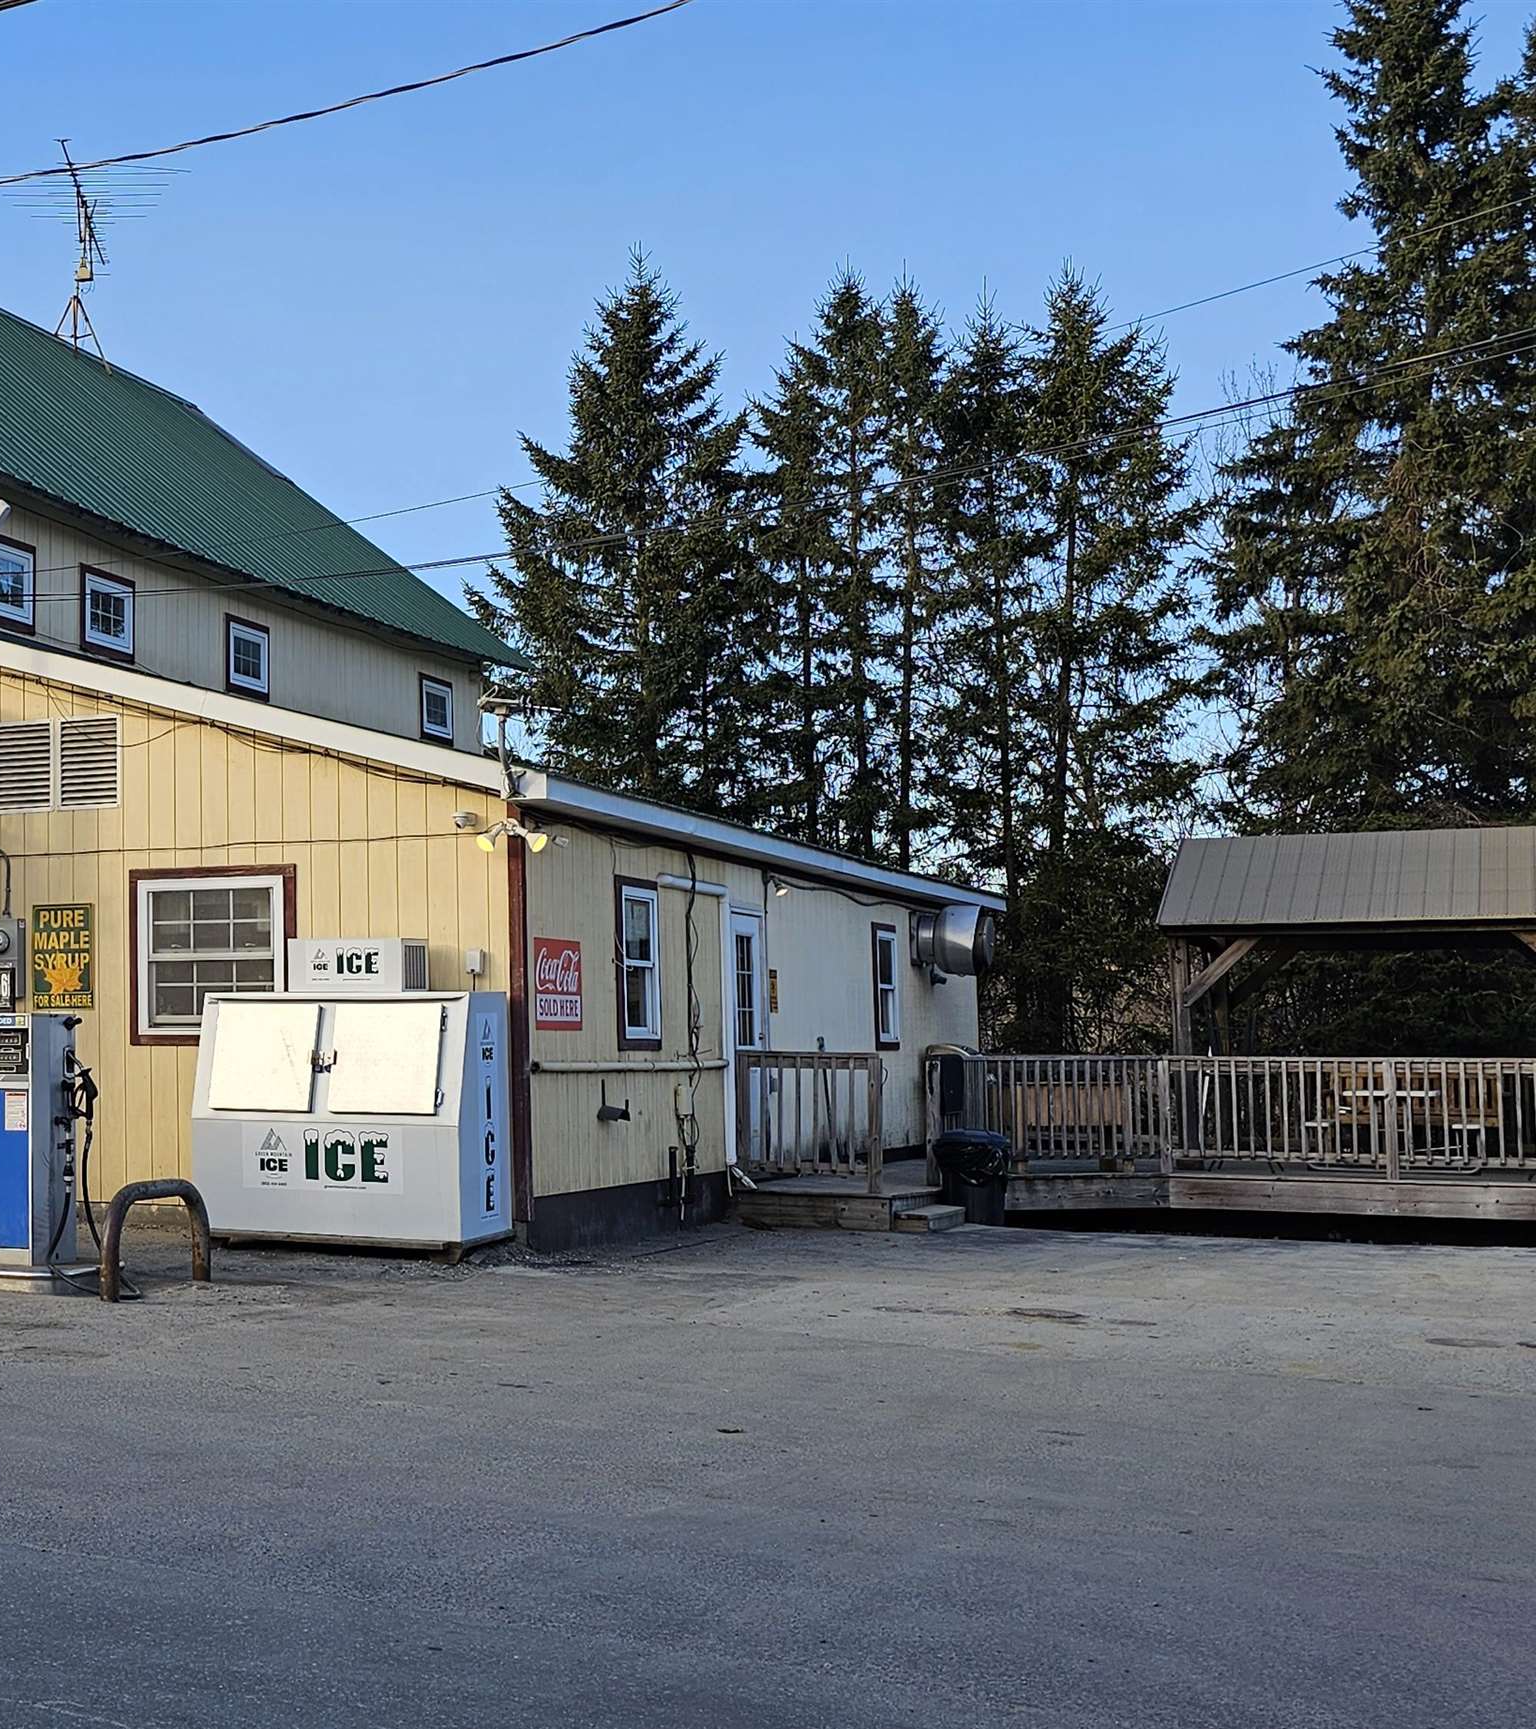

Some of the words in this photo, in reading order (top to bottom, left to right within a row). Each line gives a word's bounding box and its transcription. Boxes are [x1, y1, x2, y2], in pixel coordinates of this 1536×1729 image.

[39, 909, 84, 928] PURE
[34, 930, 90, 950] MAPLE
[34, 952, 90, 970] SYRUP
[336, 947, 379, 974] ICE
[34, 995, 49, 1007] FOR
[51, 995, 71, 1007] SALE
[72, 994, 92, 1006] HERE
[539, 998, 558, 1017] SOLD
[560, 999, 579, 1017] HERE
[482, 1047, 494, 1060] ICE
[260, 1158, 288, 1172] ICE
[303, 1128, 389, 1183] ICE
